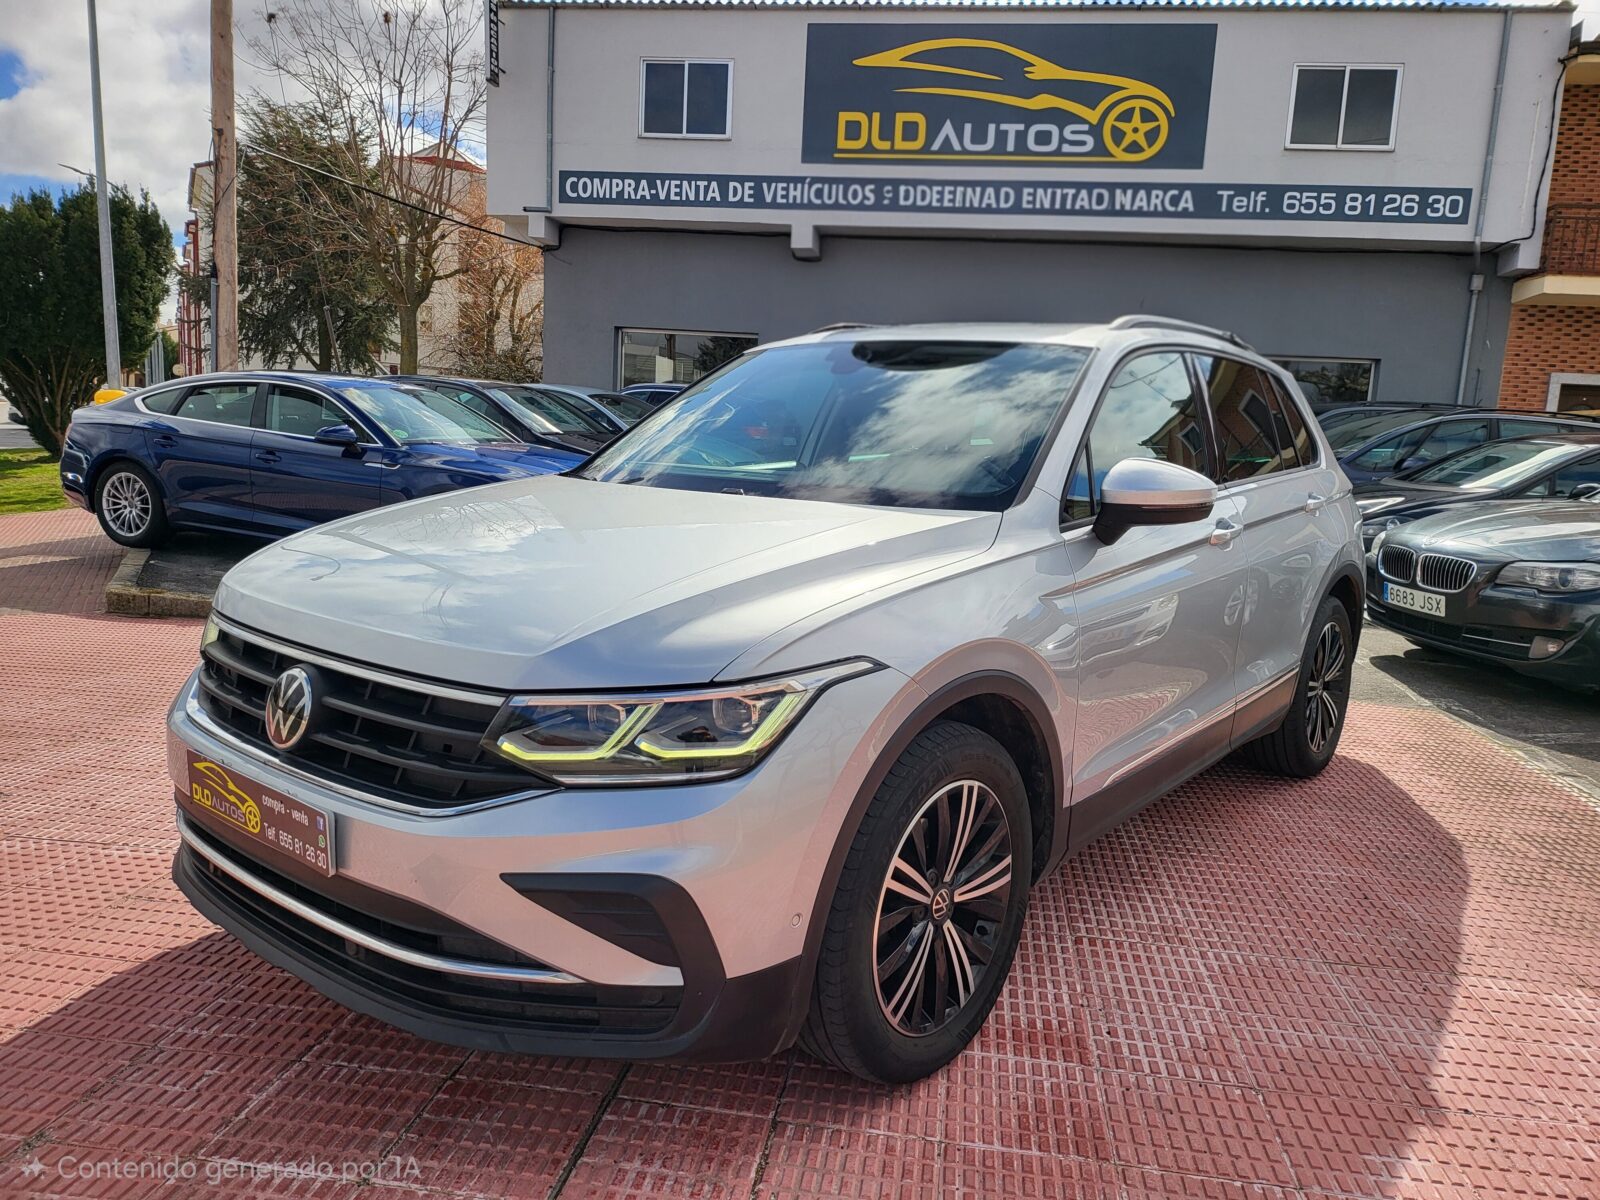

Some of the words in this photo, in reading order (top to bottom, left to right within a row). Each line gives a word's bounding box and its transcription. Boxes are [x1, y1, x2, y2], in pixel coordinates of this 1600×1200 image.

[836, 111, 927, 150] DLD
[930, 118, 1095, 153] AUTOS
[565, 177, 721, 202] COMPRA-VENTA
[728, 181, 754, 203] DE
[762, 178, 876, 206] VEHÍCULOS
[1217, 190, 1270, 213] Telf.
[1282, 191, 1336, 215] 655
[1426, 195, 1463, 218] 30
[1389, 587, 1415, 607] 6683
[1419, 595, 1442, 614] JSX
[192, 783, 211, 806] DLD
[211, 795, 246, 823] AUTOS
[262, 794, 285, 815] compra
[291, 809, 309, 826] venta
[263, 822, 278, 842] Telf.
[278, 830, 294, 851] 655
[294, 838, 304, 857] 81
[305, 844, 316, 863] 26
[316, 850, 327, 869] 30
